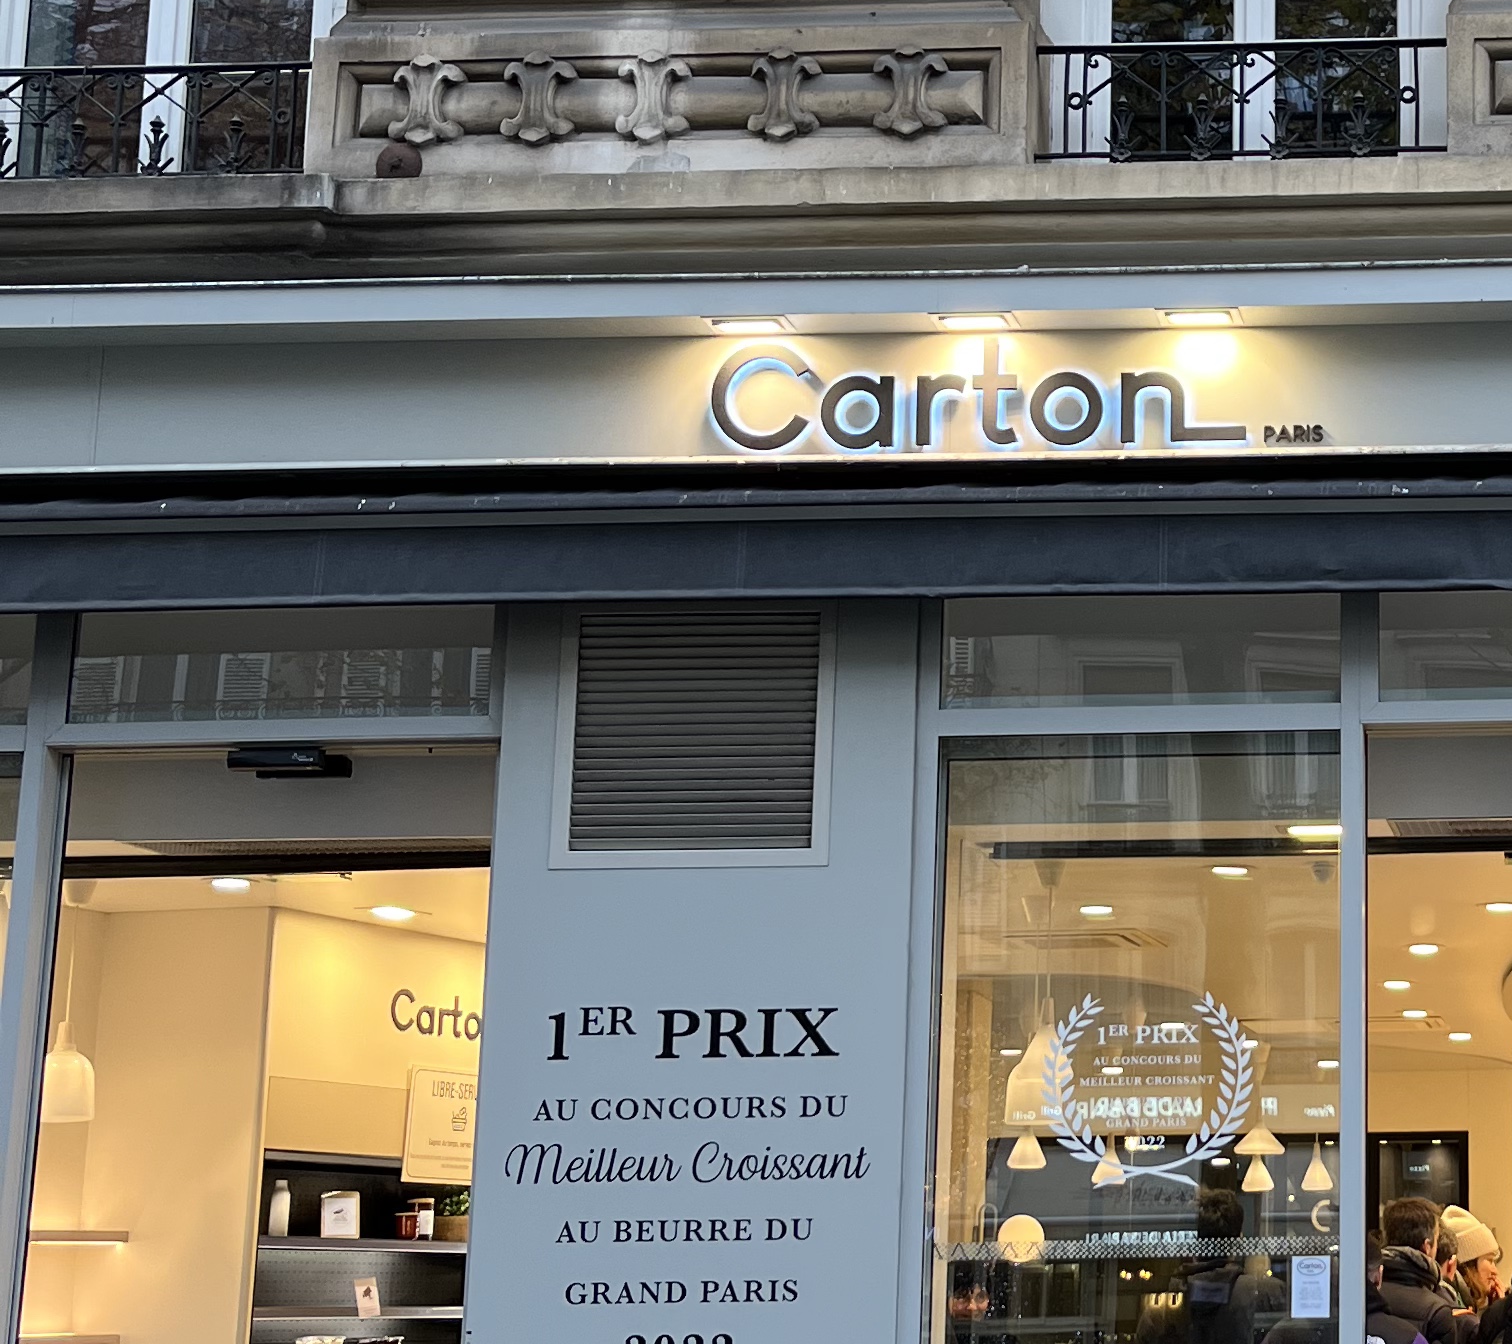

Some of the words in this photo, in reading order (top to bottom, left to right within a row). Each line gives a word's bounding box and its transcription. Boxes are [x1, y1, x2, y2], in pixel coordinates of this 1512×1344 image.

[710, 337, 1246, 451] Carton
[1262, 424, 1325, 444] PARIS
[390, 988, 483, 1041] Carto
[546, 1005, 637, 1061] 1ER
[654, 1006, 840, 1060] PRIX
[1097, 1024, 1130, 1045] 1ER
[1135, 1023, 1200, 1045] PRIX
[1092, 1056, 1109, 1066] AU
[1112, 1054, 1181, 1066] CONCOURS
[1184, 1054, 1202, 1065] DU
[1079, 1076, 1143, 1087] MEILLEUR
[1145, 1074, 1216, 1085] CROISSANT
[531, 1097, 580, 1123] AU
[589, 1095, 787, 1122] CONCOURS
[798, 1094, 849, 1119] DU
[1105, 1117, 1149, 1128] GRAND
[1152, 1117, 1187, 1127] PARIS
[1125, 1135, 1166, 1149] 022
[504, 1142, 682, 1185] Meilleur
[692, 1141, 871, 1184] Croissant
[554, 1219, 602, 1244] AU
[611, 1217, 753, 1243] BEURRE
[763, 1217, 814, 1242] DU
[564, 1280, 688, 1306] GRAND
[699, 1278, 799, 1304] PARIS
